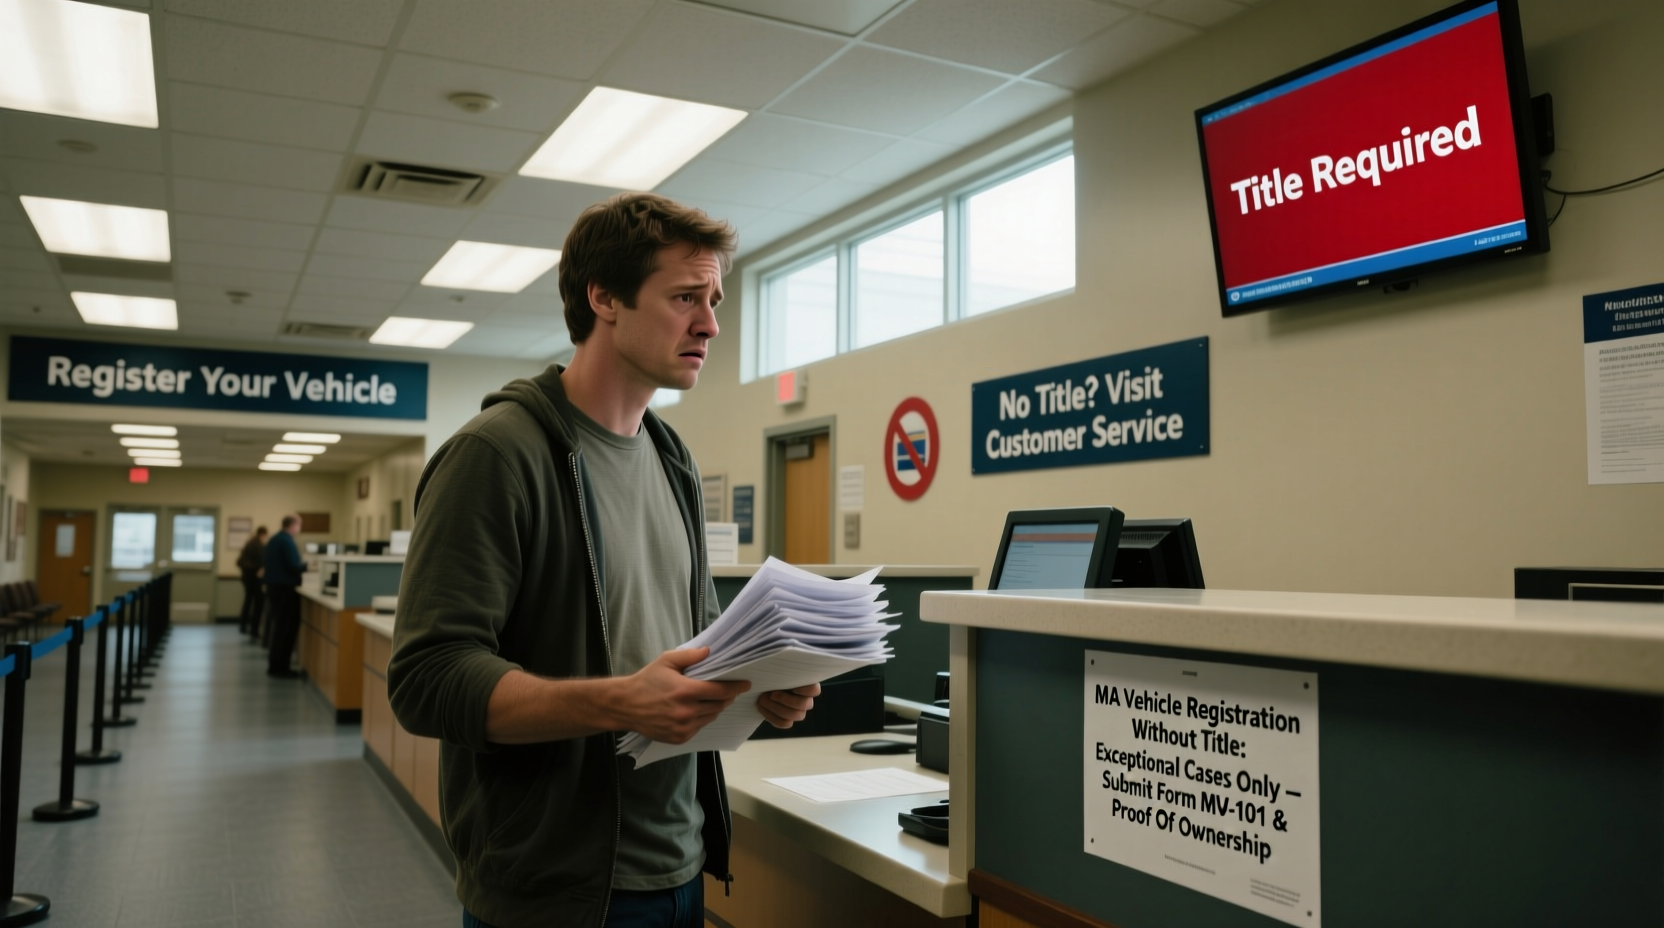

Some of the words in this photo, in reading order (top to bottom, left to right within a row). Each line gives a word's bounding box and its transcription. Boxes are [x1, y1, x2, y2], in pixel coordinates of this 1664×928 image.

[1230, 167, 1303, 215] Title
[1310, 105, 1482, 193] Required
[47, 355, 191, 397] Register
[201, 366, 276, 398] Your
[285, 371, 397, 405] Vehicle
[999, 389, 1031, 420] No
[1035, 375, 1099, 415] Title?
[1105, 366, 1163, 404] Visit
[986, 426, 1087, 459] Customer
[1092, 408, 1184, 447] Service
[1095, 684, 1120, 706] MA
[1123, 687, 1182, 716] Vehicle
[1187, 696, 1300, 734] Registration
[1132, 718, 1197, 750] Without
[1201, 729, 1246, 758] Title:
[1096, 742, 1180, 777] Exceptional
[1184, 759, 1232, 788] Cases
[1236, 770, 1280, 804] Only
[1102, 770, 1153, 800] Submit
[1157, 782, 1196, 810] Form
[1201, 791, 1265, 827] MV-101
[1273, 809, 1288, 832] &
[1112, 798, 1152, 826] Proof
[1156, 808, 1176, 832] Of
[1179, 816, 1272, 864] Ownership
